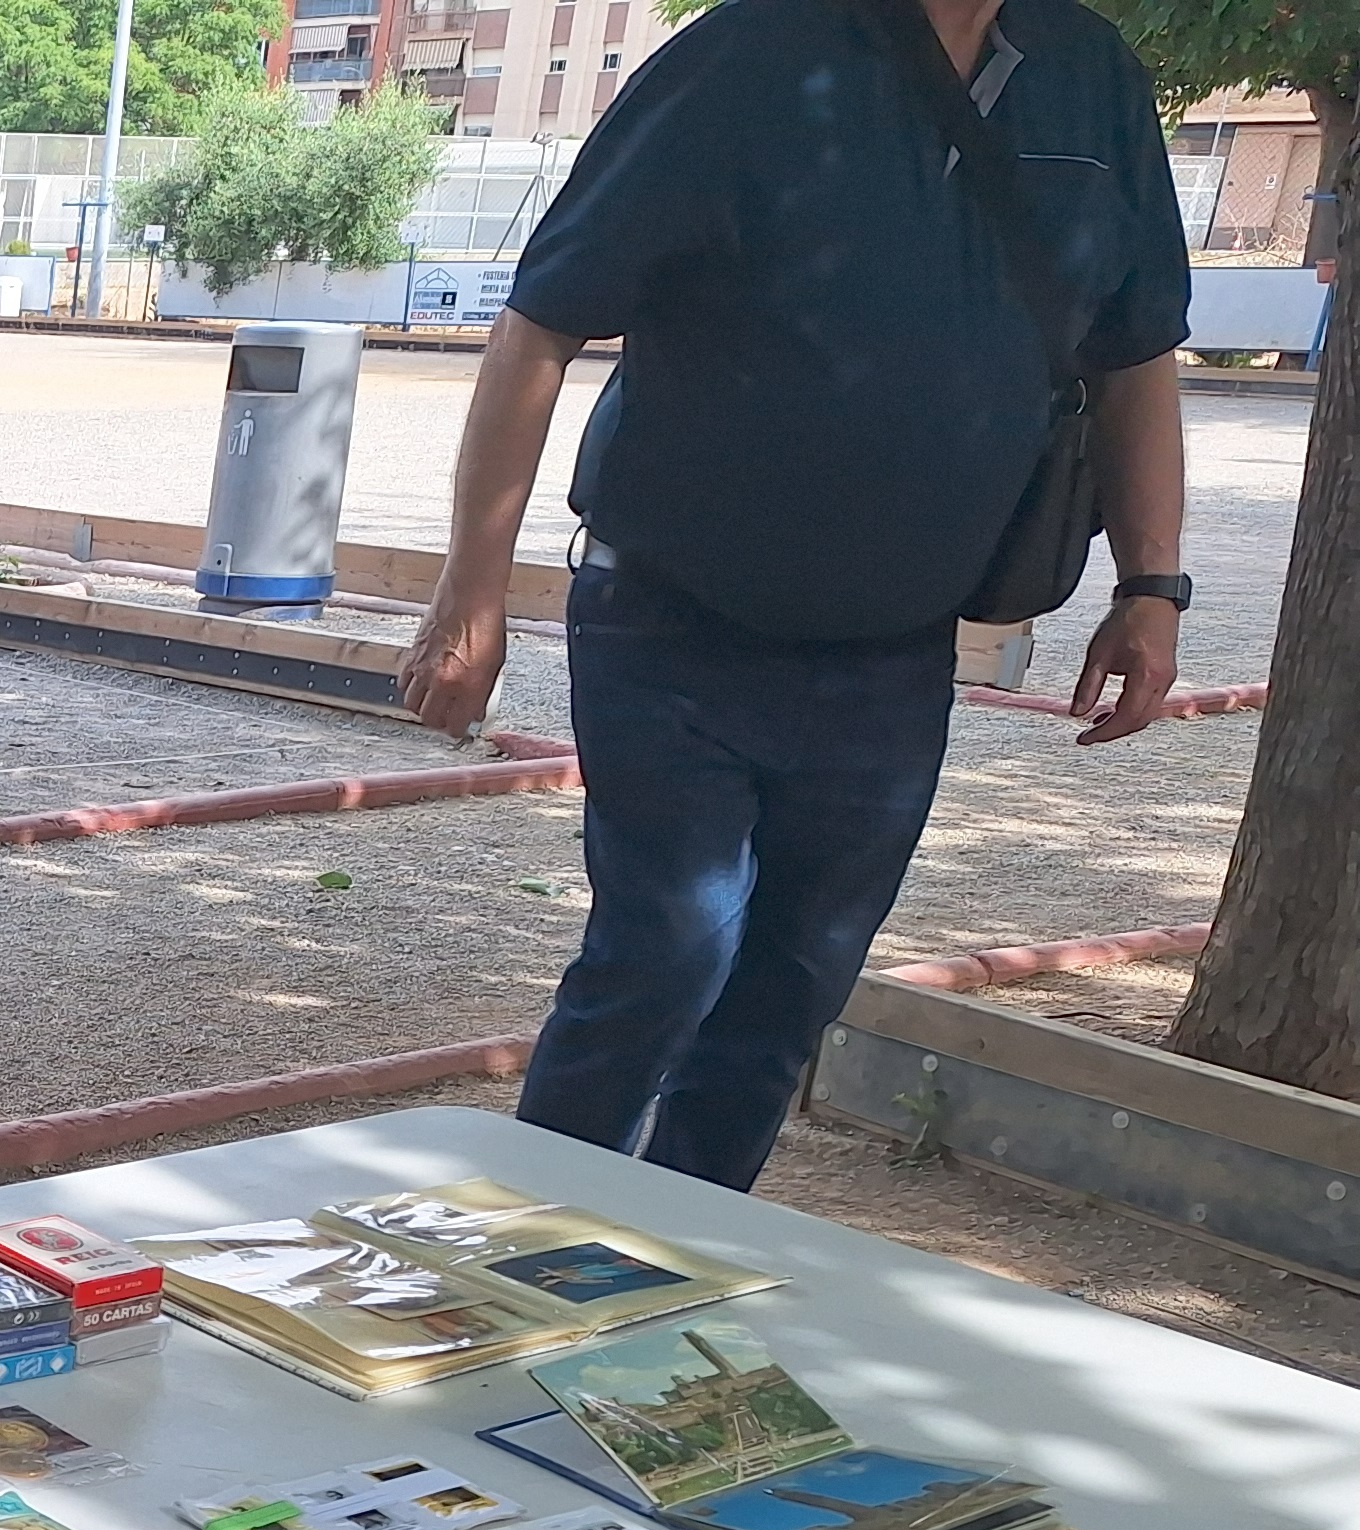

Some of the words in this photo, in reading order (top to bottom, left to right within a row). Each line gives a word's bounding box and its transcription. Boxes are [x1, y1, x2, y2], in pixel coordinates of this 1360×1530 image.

[410, 312, 455, 320] EDUTEC
[53, 1249, 118, 1265] REIG
[83, 1312, 99, 1326] 50
[101, 1301, 154, 1323] CARTAS
